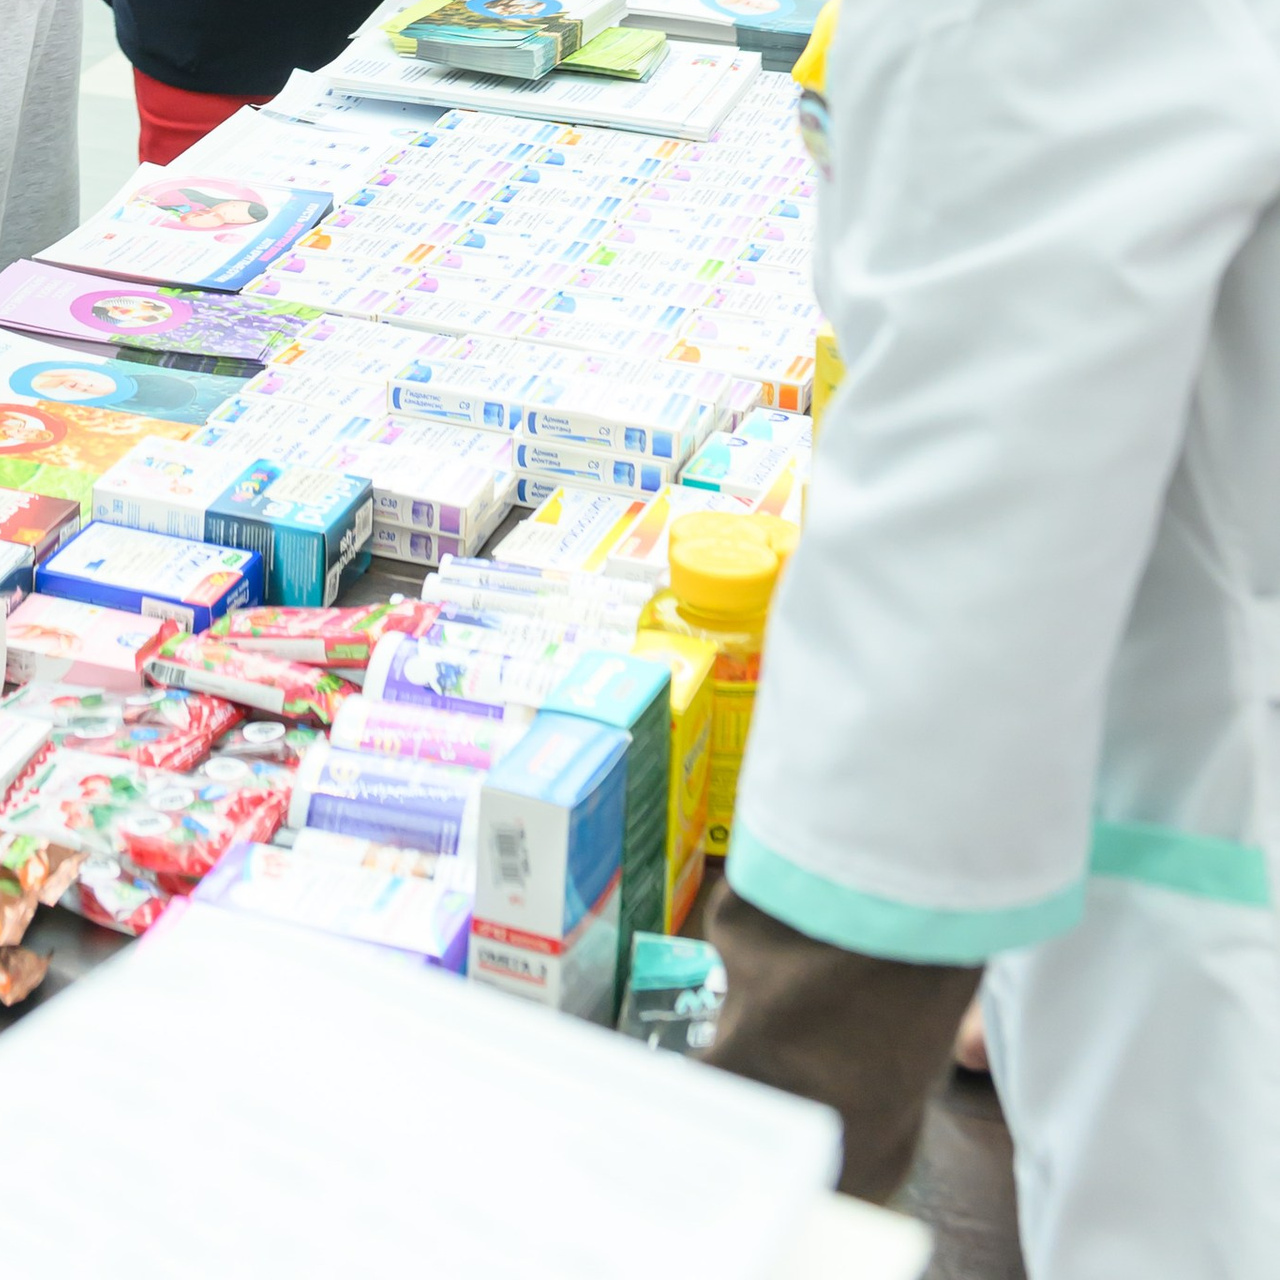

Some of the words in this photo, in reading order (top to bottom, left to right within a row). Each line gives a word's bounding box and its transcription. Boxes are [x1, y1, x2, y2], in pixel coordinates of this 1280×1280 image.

[405, 389, 442, 403] Гидрастис
[542, 413, 569, 426] Арника
[542, 422, 572, 434] монтана
[531, 447, 559, 459] Арника
[531, 456, 561, 468] монтана
[380, 497, 398, 509] C30
[379, 529, 396, 542] C30
